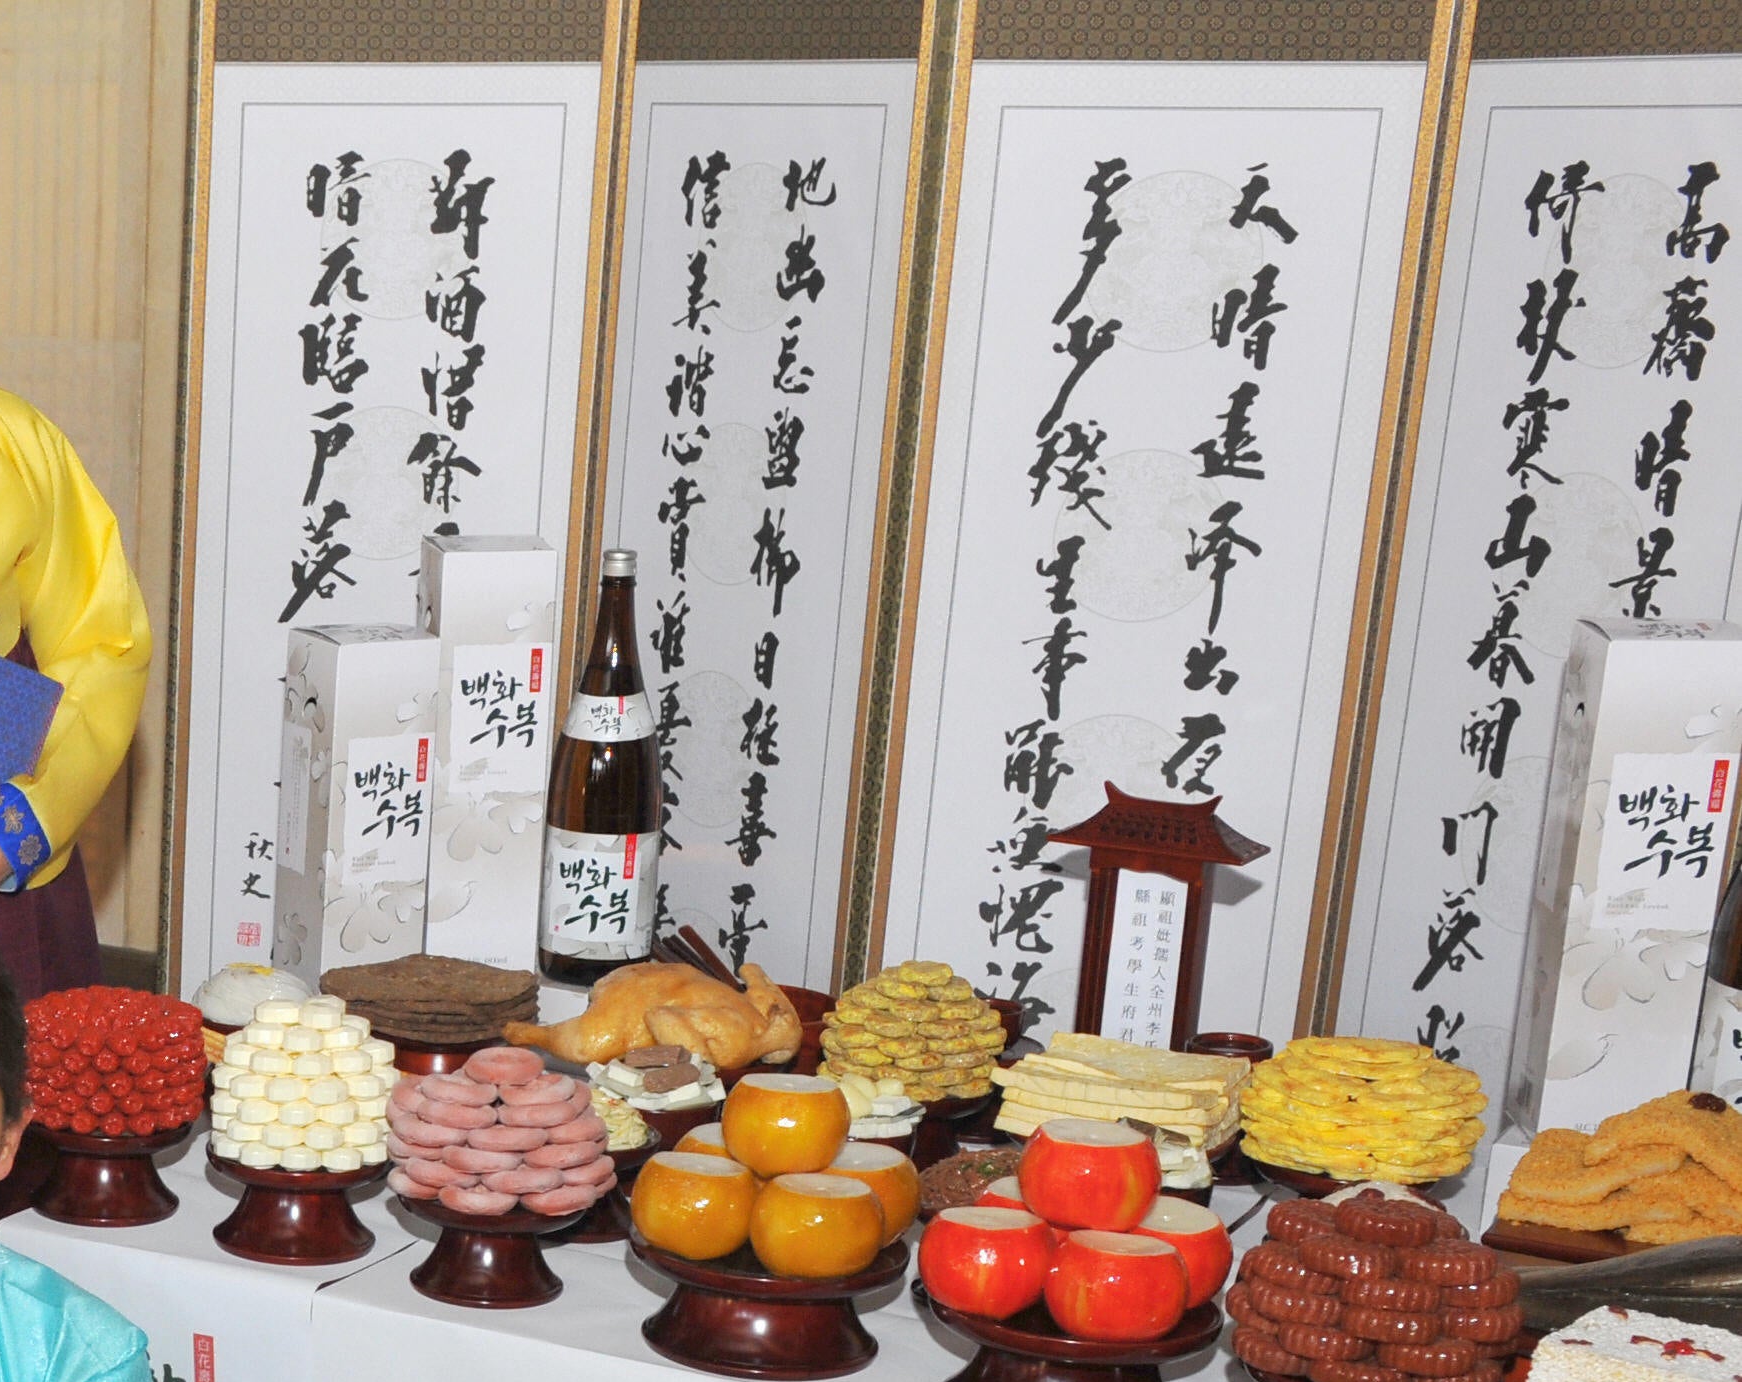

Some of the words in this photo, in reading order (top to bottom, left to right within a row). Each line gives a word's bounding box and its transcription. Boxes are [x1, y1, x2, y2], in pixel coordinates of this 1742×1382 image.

[461, 670, 523, 707] 백화
[469, 700, 538, 748] 수복
[591, 703, 616, 719] 백화
[594, 716, 622, 735] 수복
[354, 761, 410, 802] 백화
[362, 790, 424, 839] 수복
[1618, 784, 1699, 832] 백화
[1623, 822, 1714, 878] 수복
[560, 858, 617, 893] 백화
[564, 889, 629, 935] 수복
